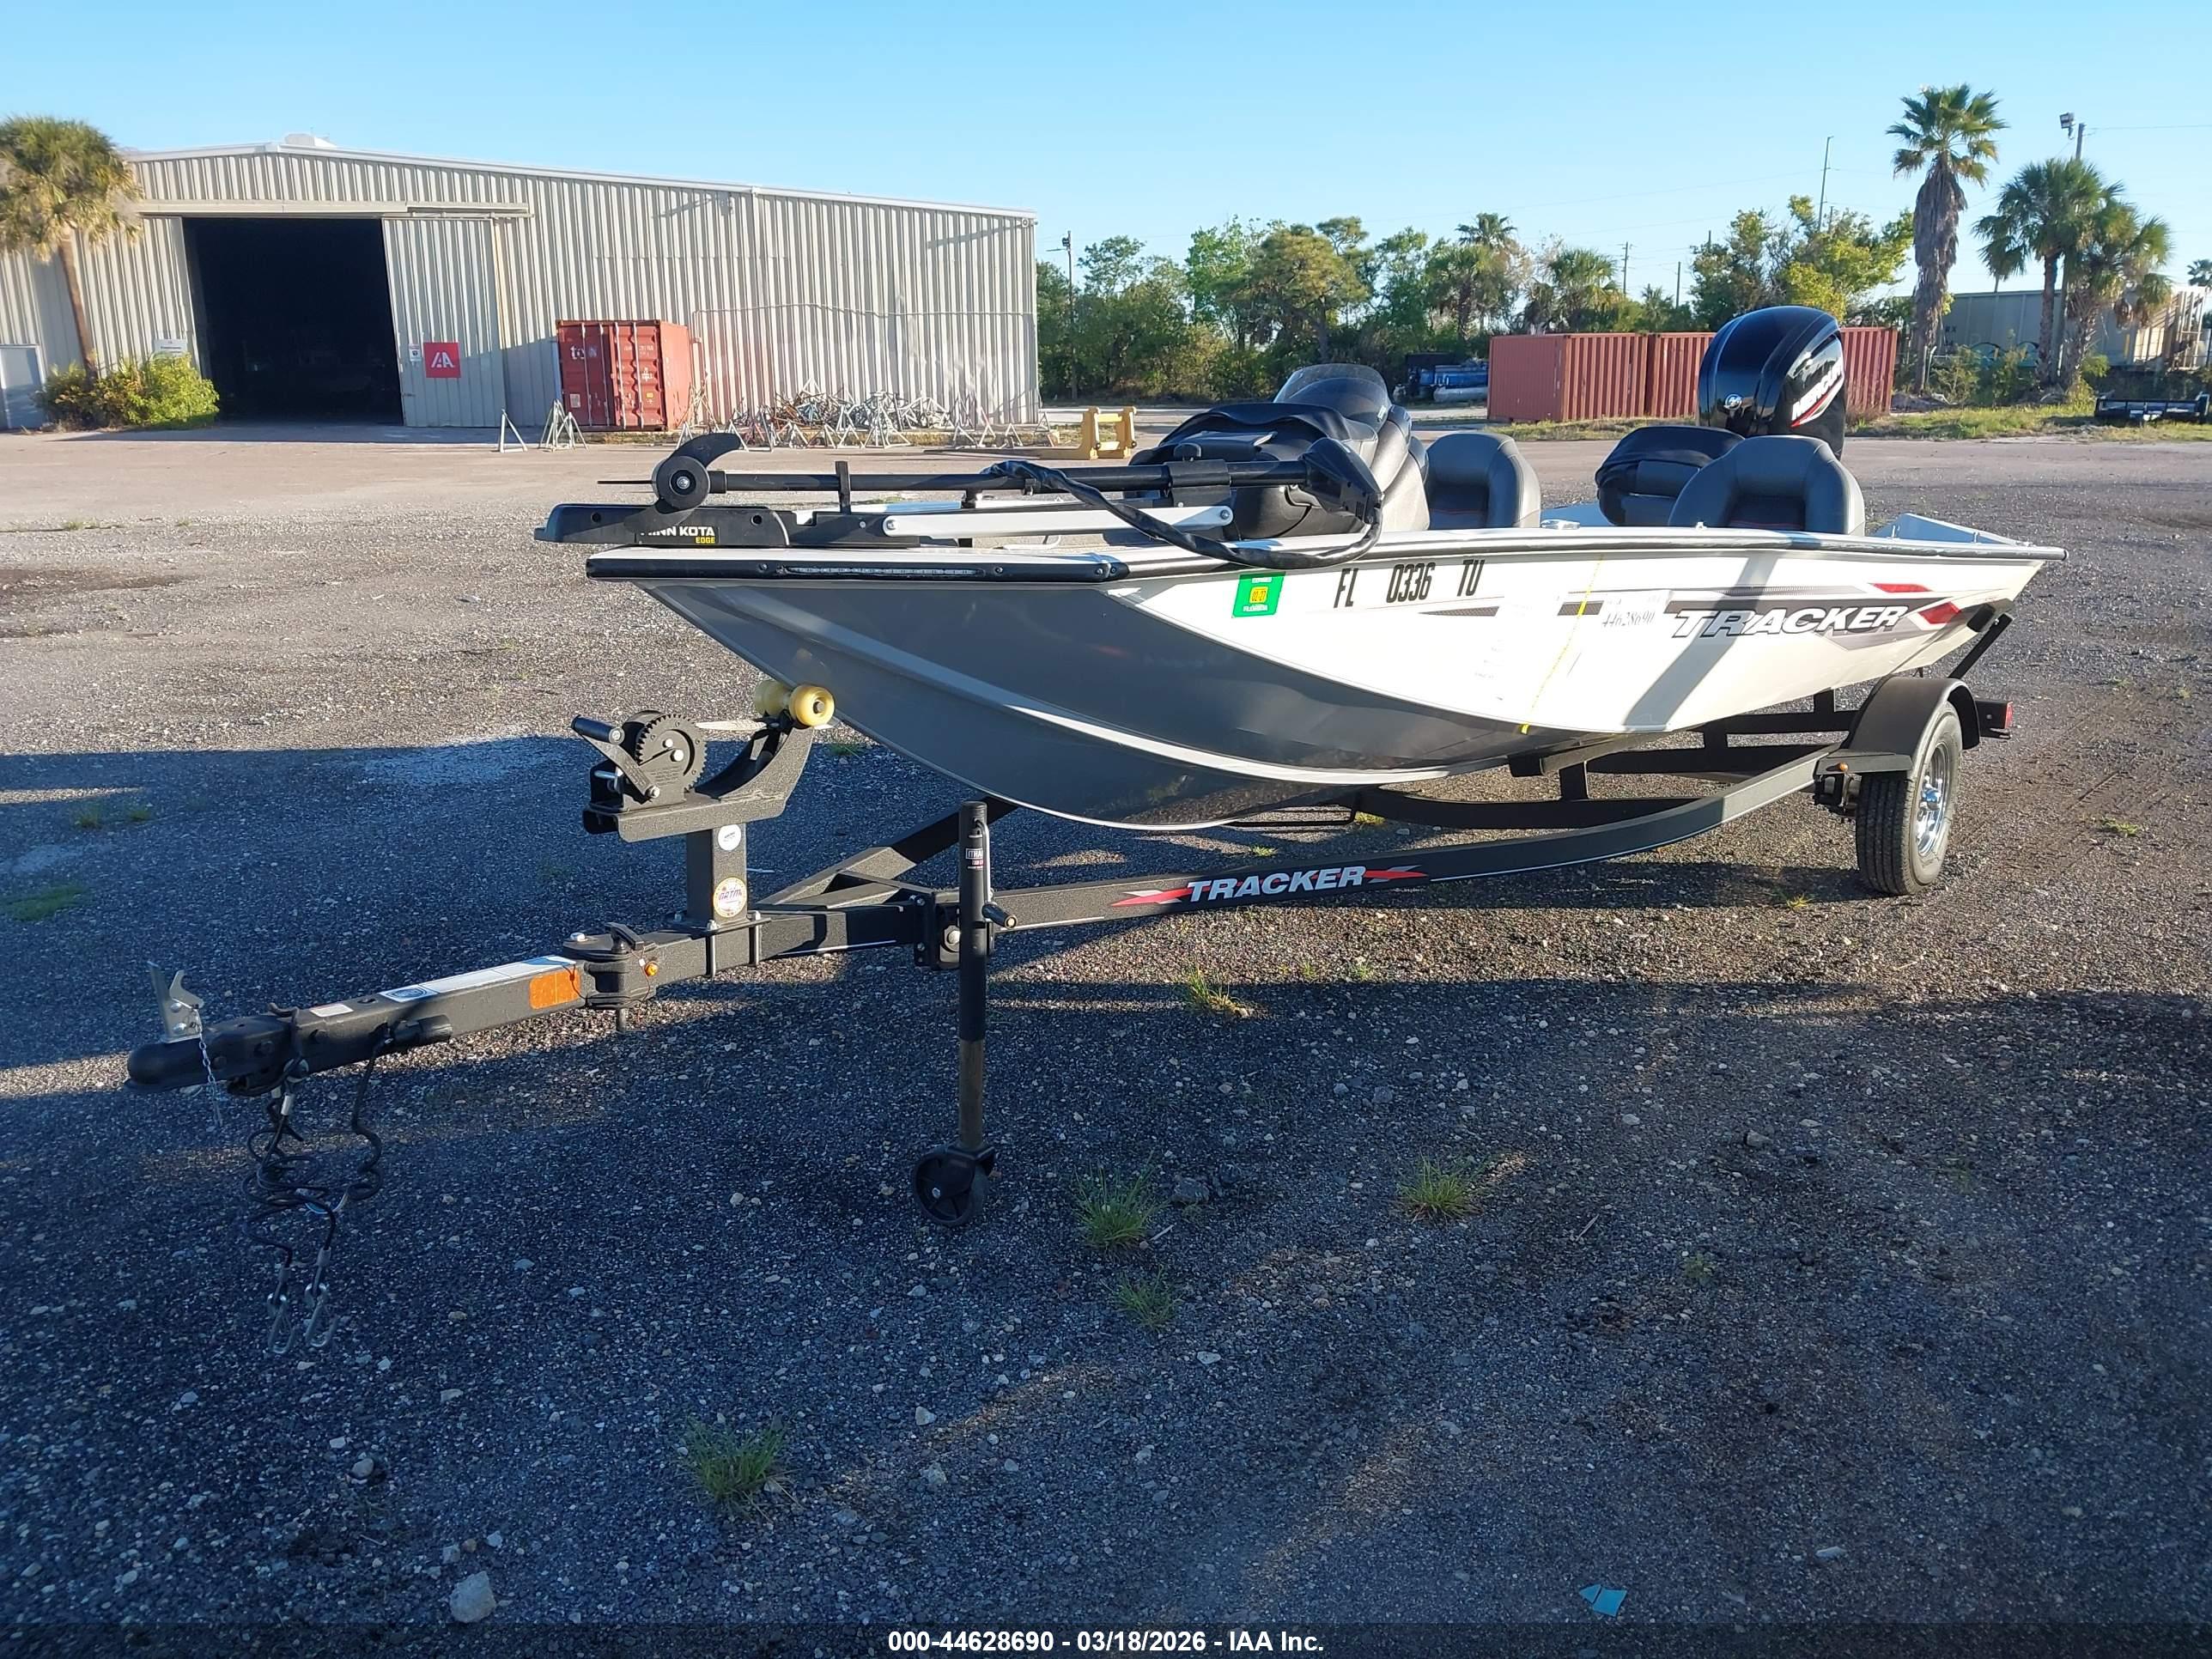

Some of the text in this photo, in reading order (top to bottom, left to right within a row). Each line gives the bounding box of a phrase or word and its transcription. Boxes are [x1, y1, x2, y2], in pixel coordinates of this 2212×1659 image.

[1791, 356, 1843, 421] MERCUR
[679, 526, 715, 536] KOTA
[1334, 559, 1486, 608] FL 0336 TU
[1672, 606, 1909, 638] TRACKER
[1187, 866, 1366, 902] TRACKER
